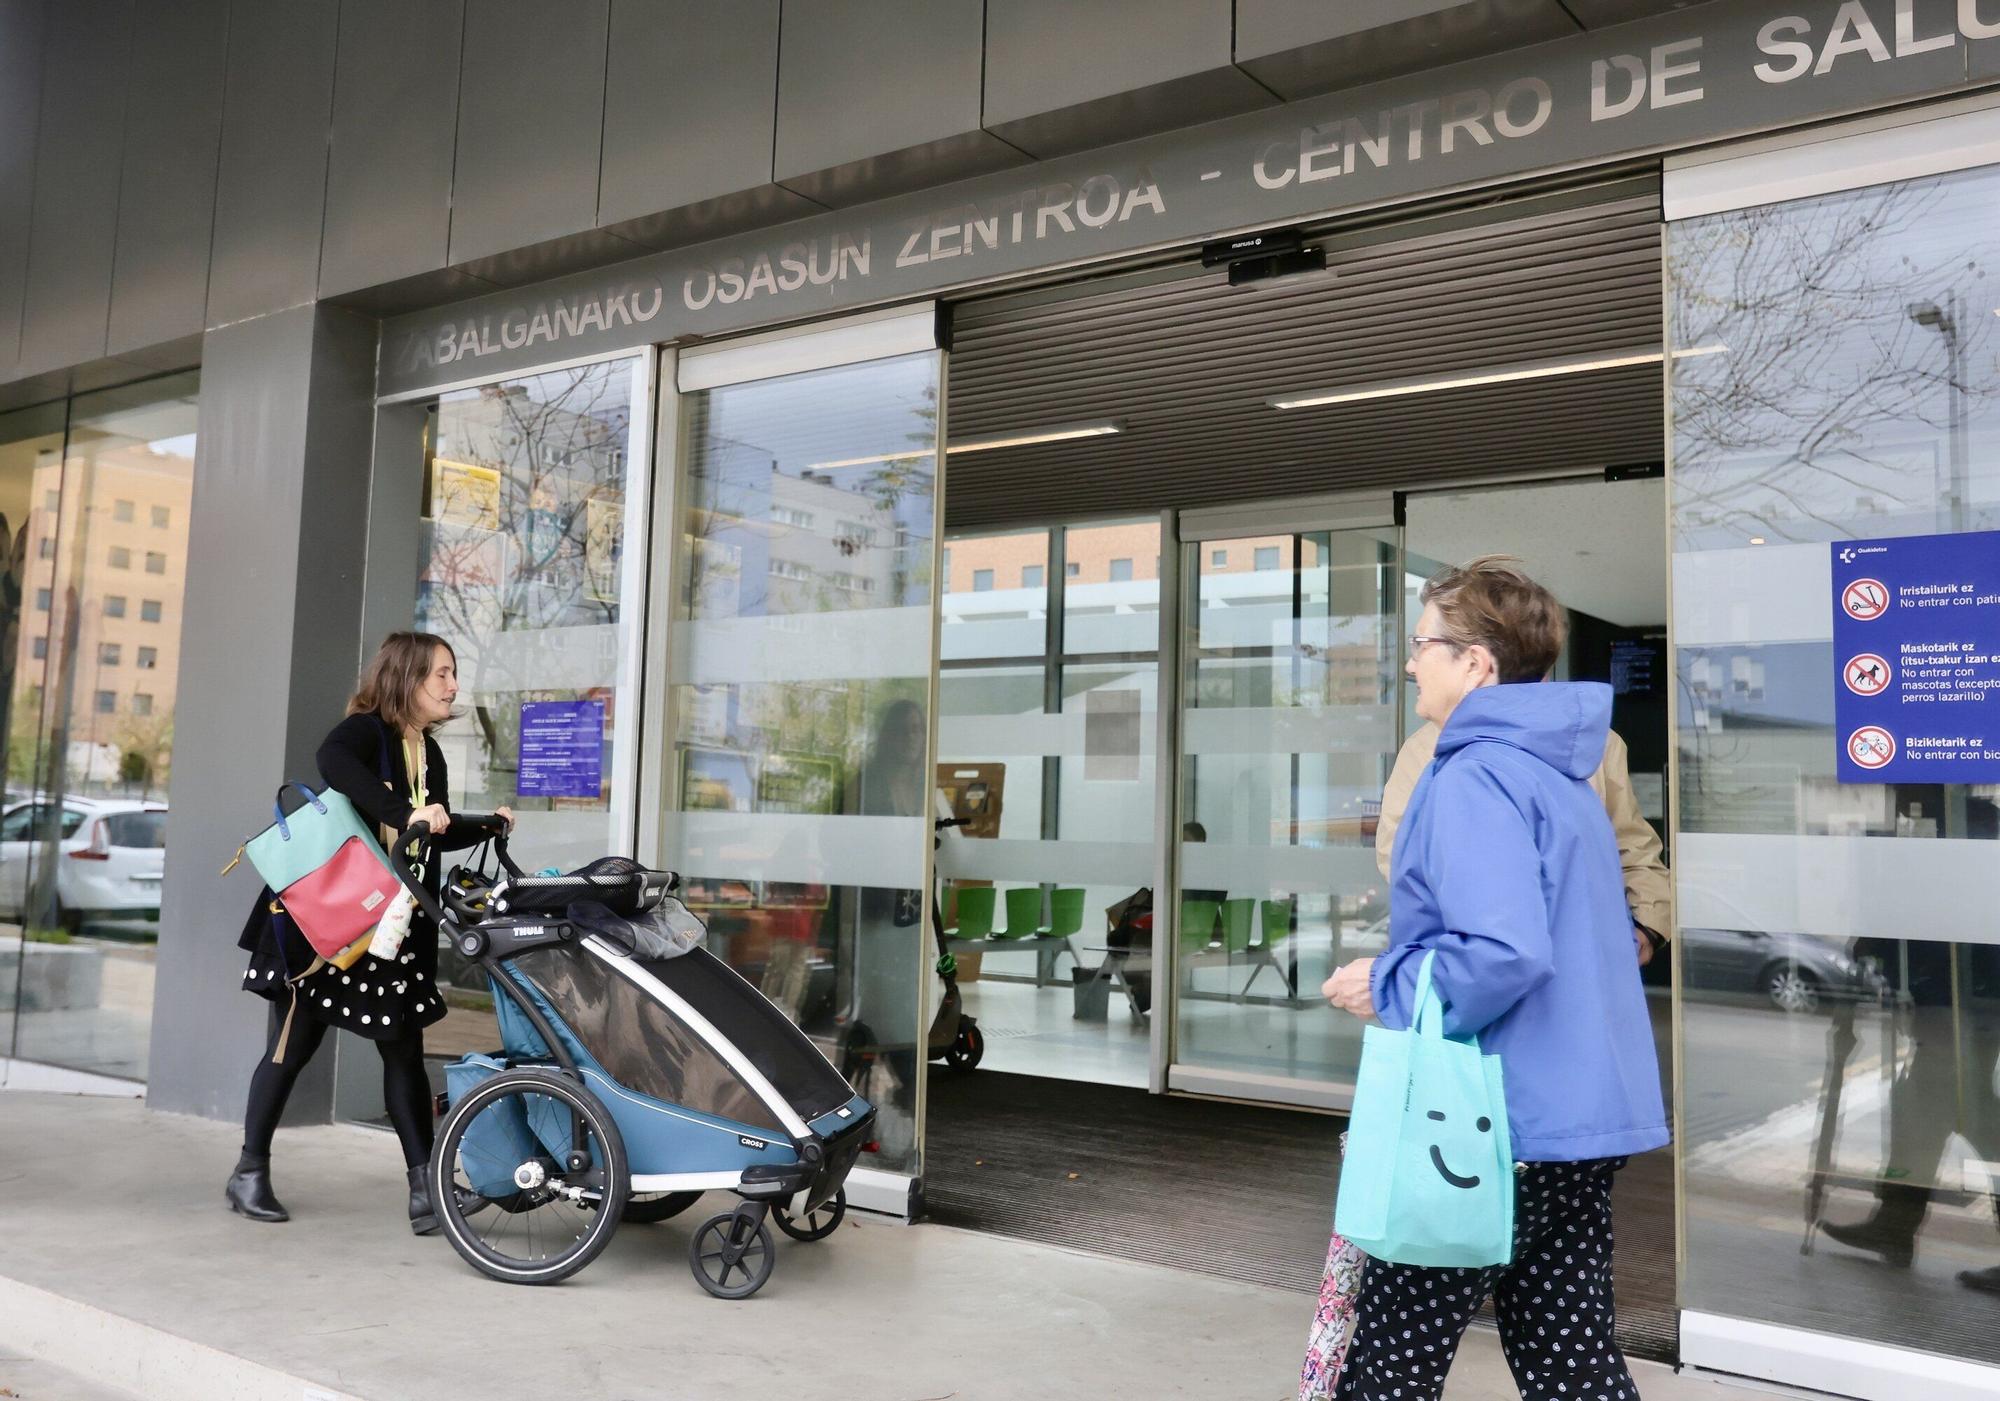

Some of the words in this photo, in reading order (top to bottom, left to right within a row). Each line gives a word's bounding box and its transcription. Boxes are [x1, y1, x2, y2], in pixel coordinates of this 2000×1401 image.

[683, 228, 871, 311] OSASUN
[895, 166, 1167, 268] ZENTROA
[1201, 170, 1222, 181] -
[1253, 77, 1553, 190] CENTRO
[1591, 37, 1704, 122] DE
[1231, 239, 1255, 249] manusa
[1899, 583, 1958, 596] Irristailurik
[1960, 584, 1974, 593] ez
[1900, 599, 1915, 608] No
[1918, 597, 1950, 607] entrar
[1952, 597, 1973, 606] con
[1900, 642, 1959, 653] Maskotarik
[1961, 643, 1975, 652] ez
[1901, 654, 1962, 667] (itsu-txakur
[1965, 654, 1988, 664] izan
[1901, 669, 1917, 678] No
[1919, 668, 1952, 678] entrar
[1954, 668, 1975, 677] con
[1901, 680, 1952, 690] mascotas
[1902, 694, 1935, 705] perros
[1938, 691, 1985, 702] lazarillo)
[1905, 736, 1967, 748] Bizikletarik
[1969, 738, 1983, 747] ez
[1906, 750, 1922, 760] No
[1924, 750, 1957, 760] entrar
[1960, 751, 1980, 760] con
[513, 925, 545, 937] THULE
[741, 1137, 764, 1149] CROSS
